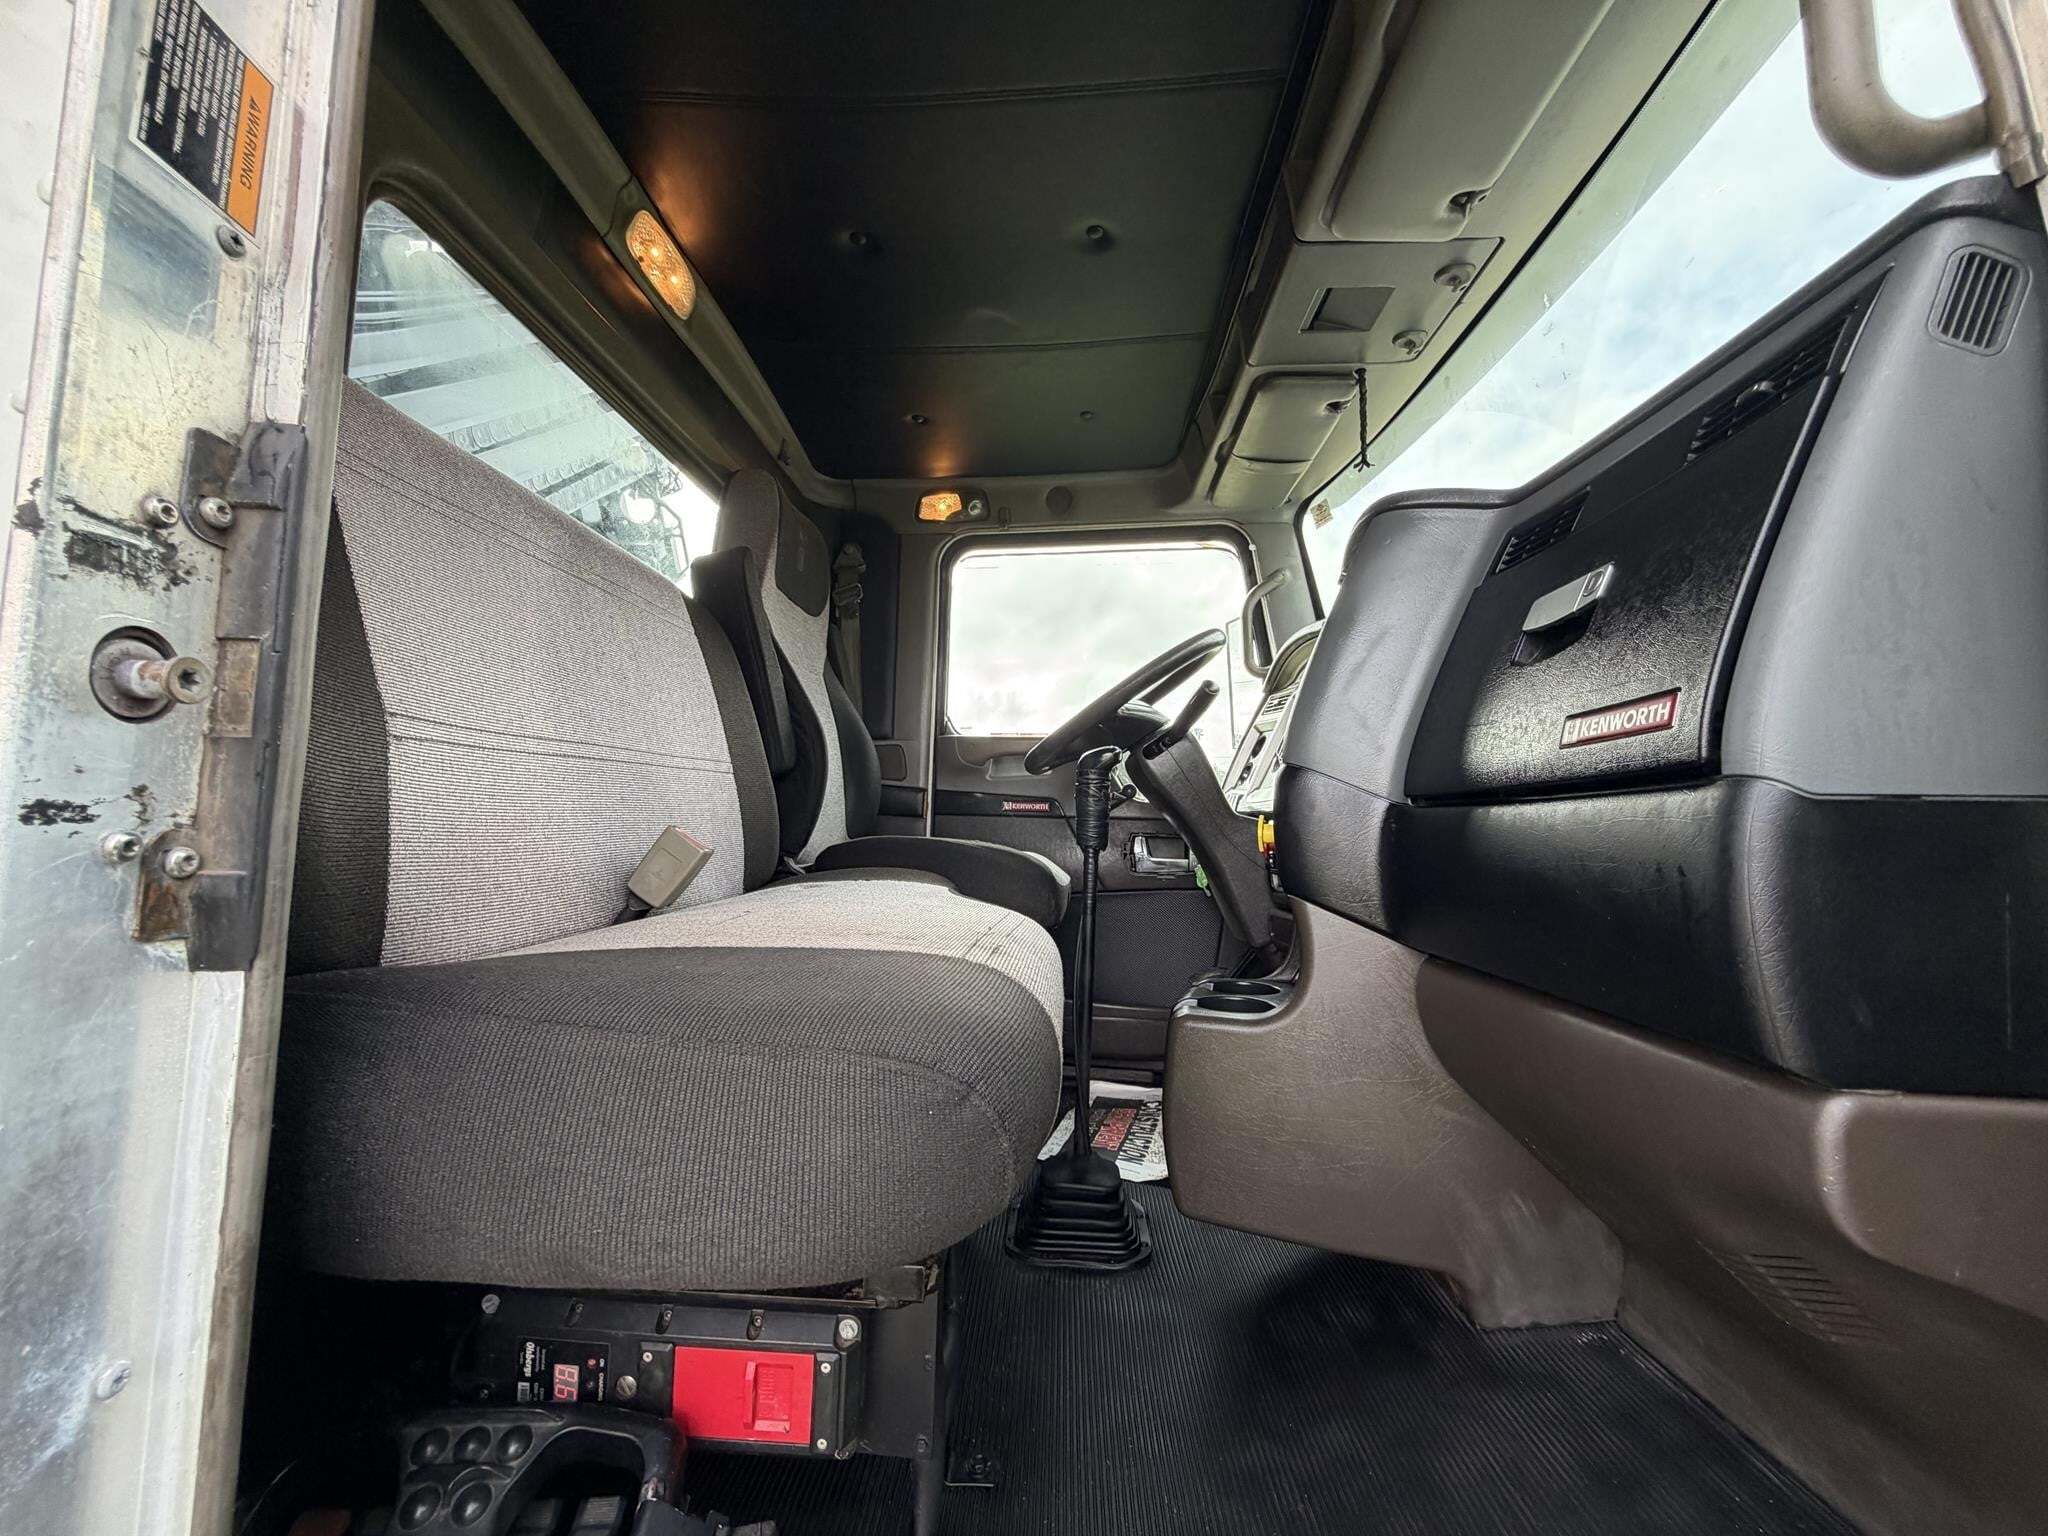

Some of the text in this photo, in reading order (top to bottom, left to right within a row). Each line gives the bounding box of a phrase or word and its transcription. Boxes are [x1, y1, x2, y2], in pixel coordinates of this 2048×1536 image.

[222, 69, 232, 109] INSTALLED
[233, 67, 242, 97] VEHICLE
[153, 108, 163, 126] AS
[177, 87, 188, 122] VEHICLE
[231, 94, 239, 111] MAY
[239, 108, 259, 192] WARNING
[1579, 701, 1672, 738] KENWORTH
[1117, 1100, 1162, 1166] CONSTRUCTION
[524, 1342, 535, 1377] Olsbergs
